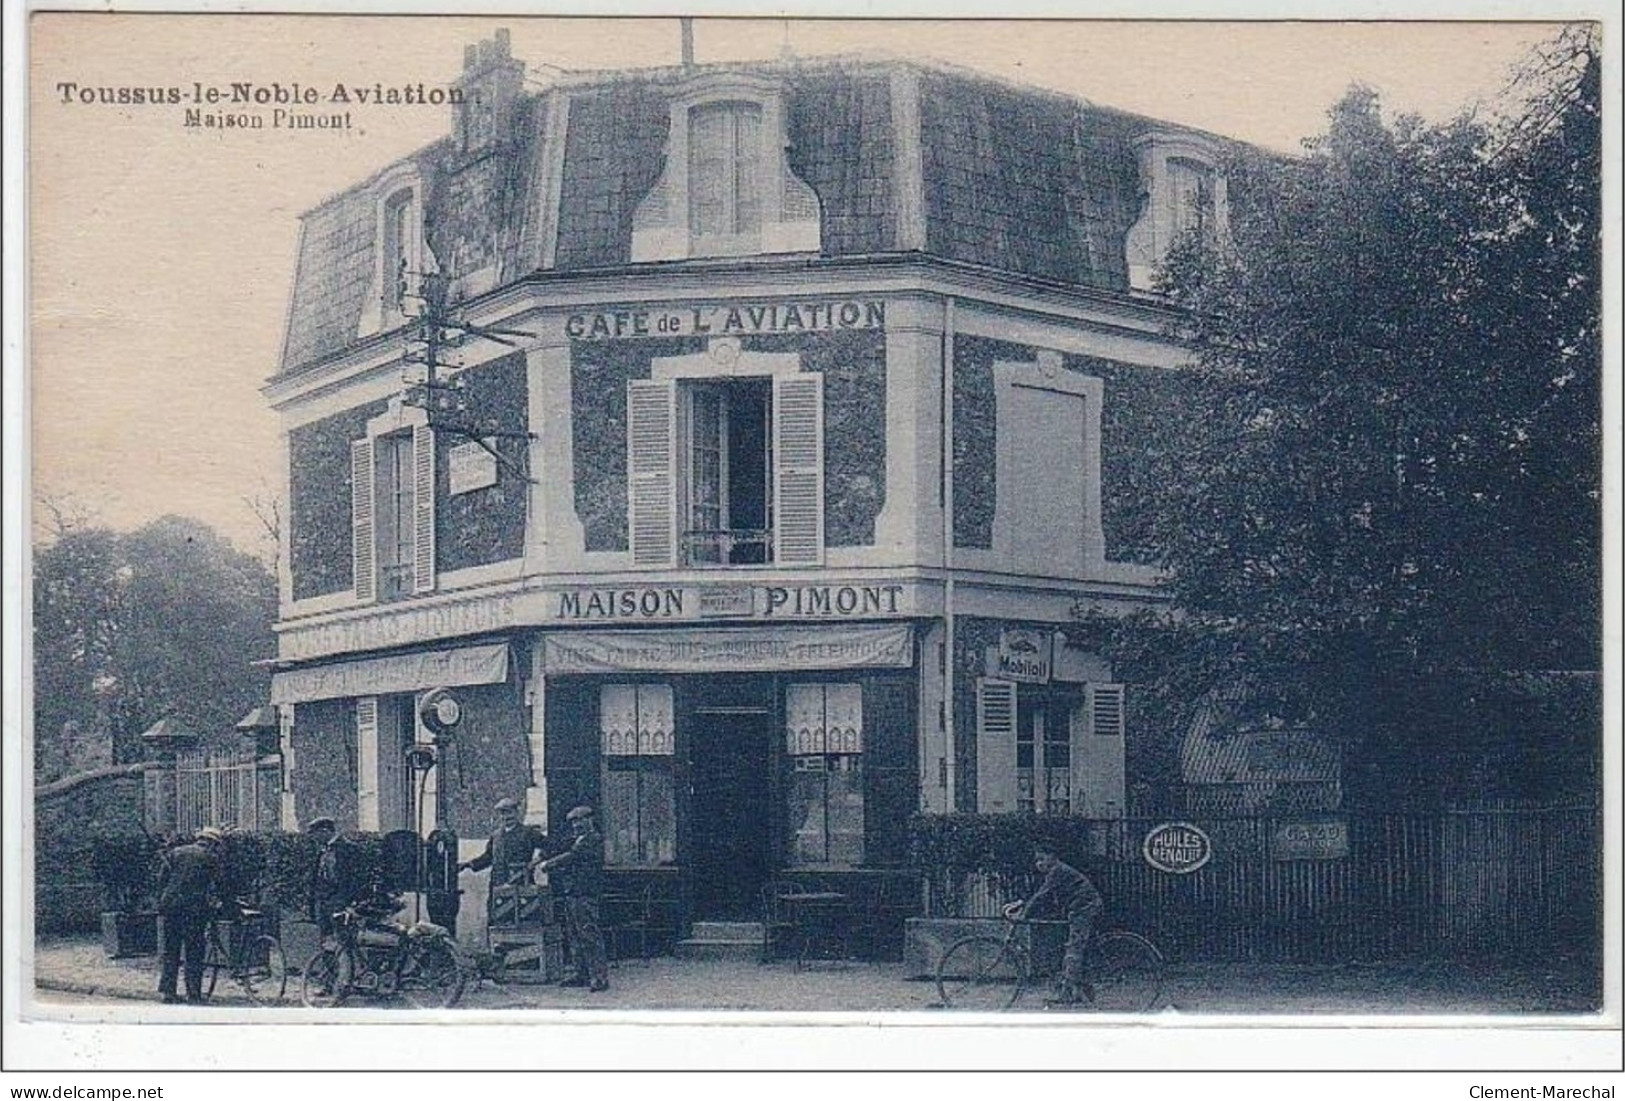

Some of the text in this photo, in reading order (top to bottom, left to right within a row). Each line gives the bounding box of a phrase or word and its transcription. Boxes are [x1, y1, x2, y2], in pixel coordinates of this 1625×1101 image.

[657, 312, 681, 333] de
[556, 589, 685, 619] MAISON
[763, 586, 904, 617] PIMONT
[1000, 656, 1047, 677] Mobiloil
[1154, 831, 1202, 848] HUILES
